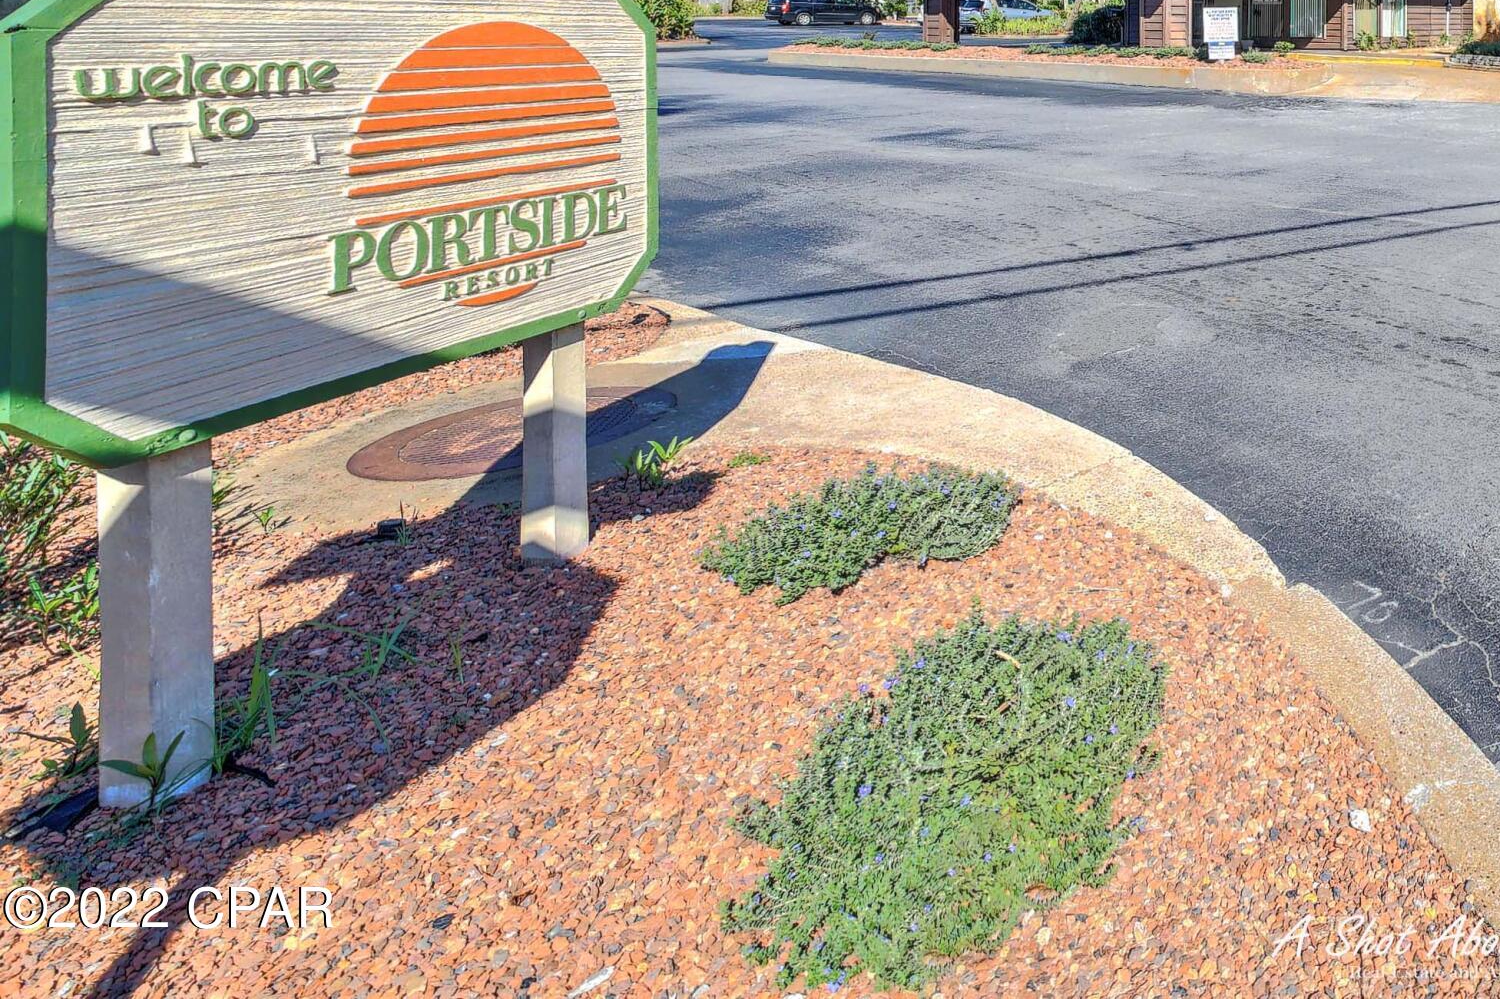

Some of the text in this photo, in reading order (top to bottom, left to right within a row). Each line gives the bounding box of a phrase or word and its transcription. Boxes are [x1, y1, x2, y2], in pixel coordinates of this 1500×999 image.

[74, 54, 338, 99] welcome
[197, 100, 256, 139] to
[326, 185, 628, 296] PORTSIDE
[442, 258, 556, 301] RESORT
